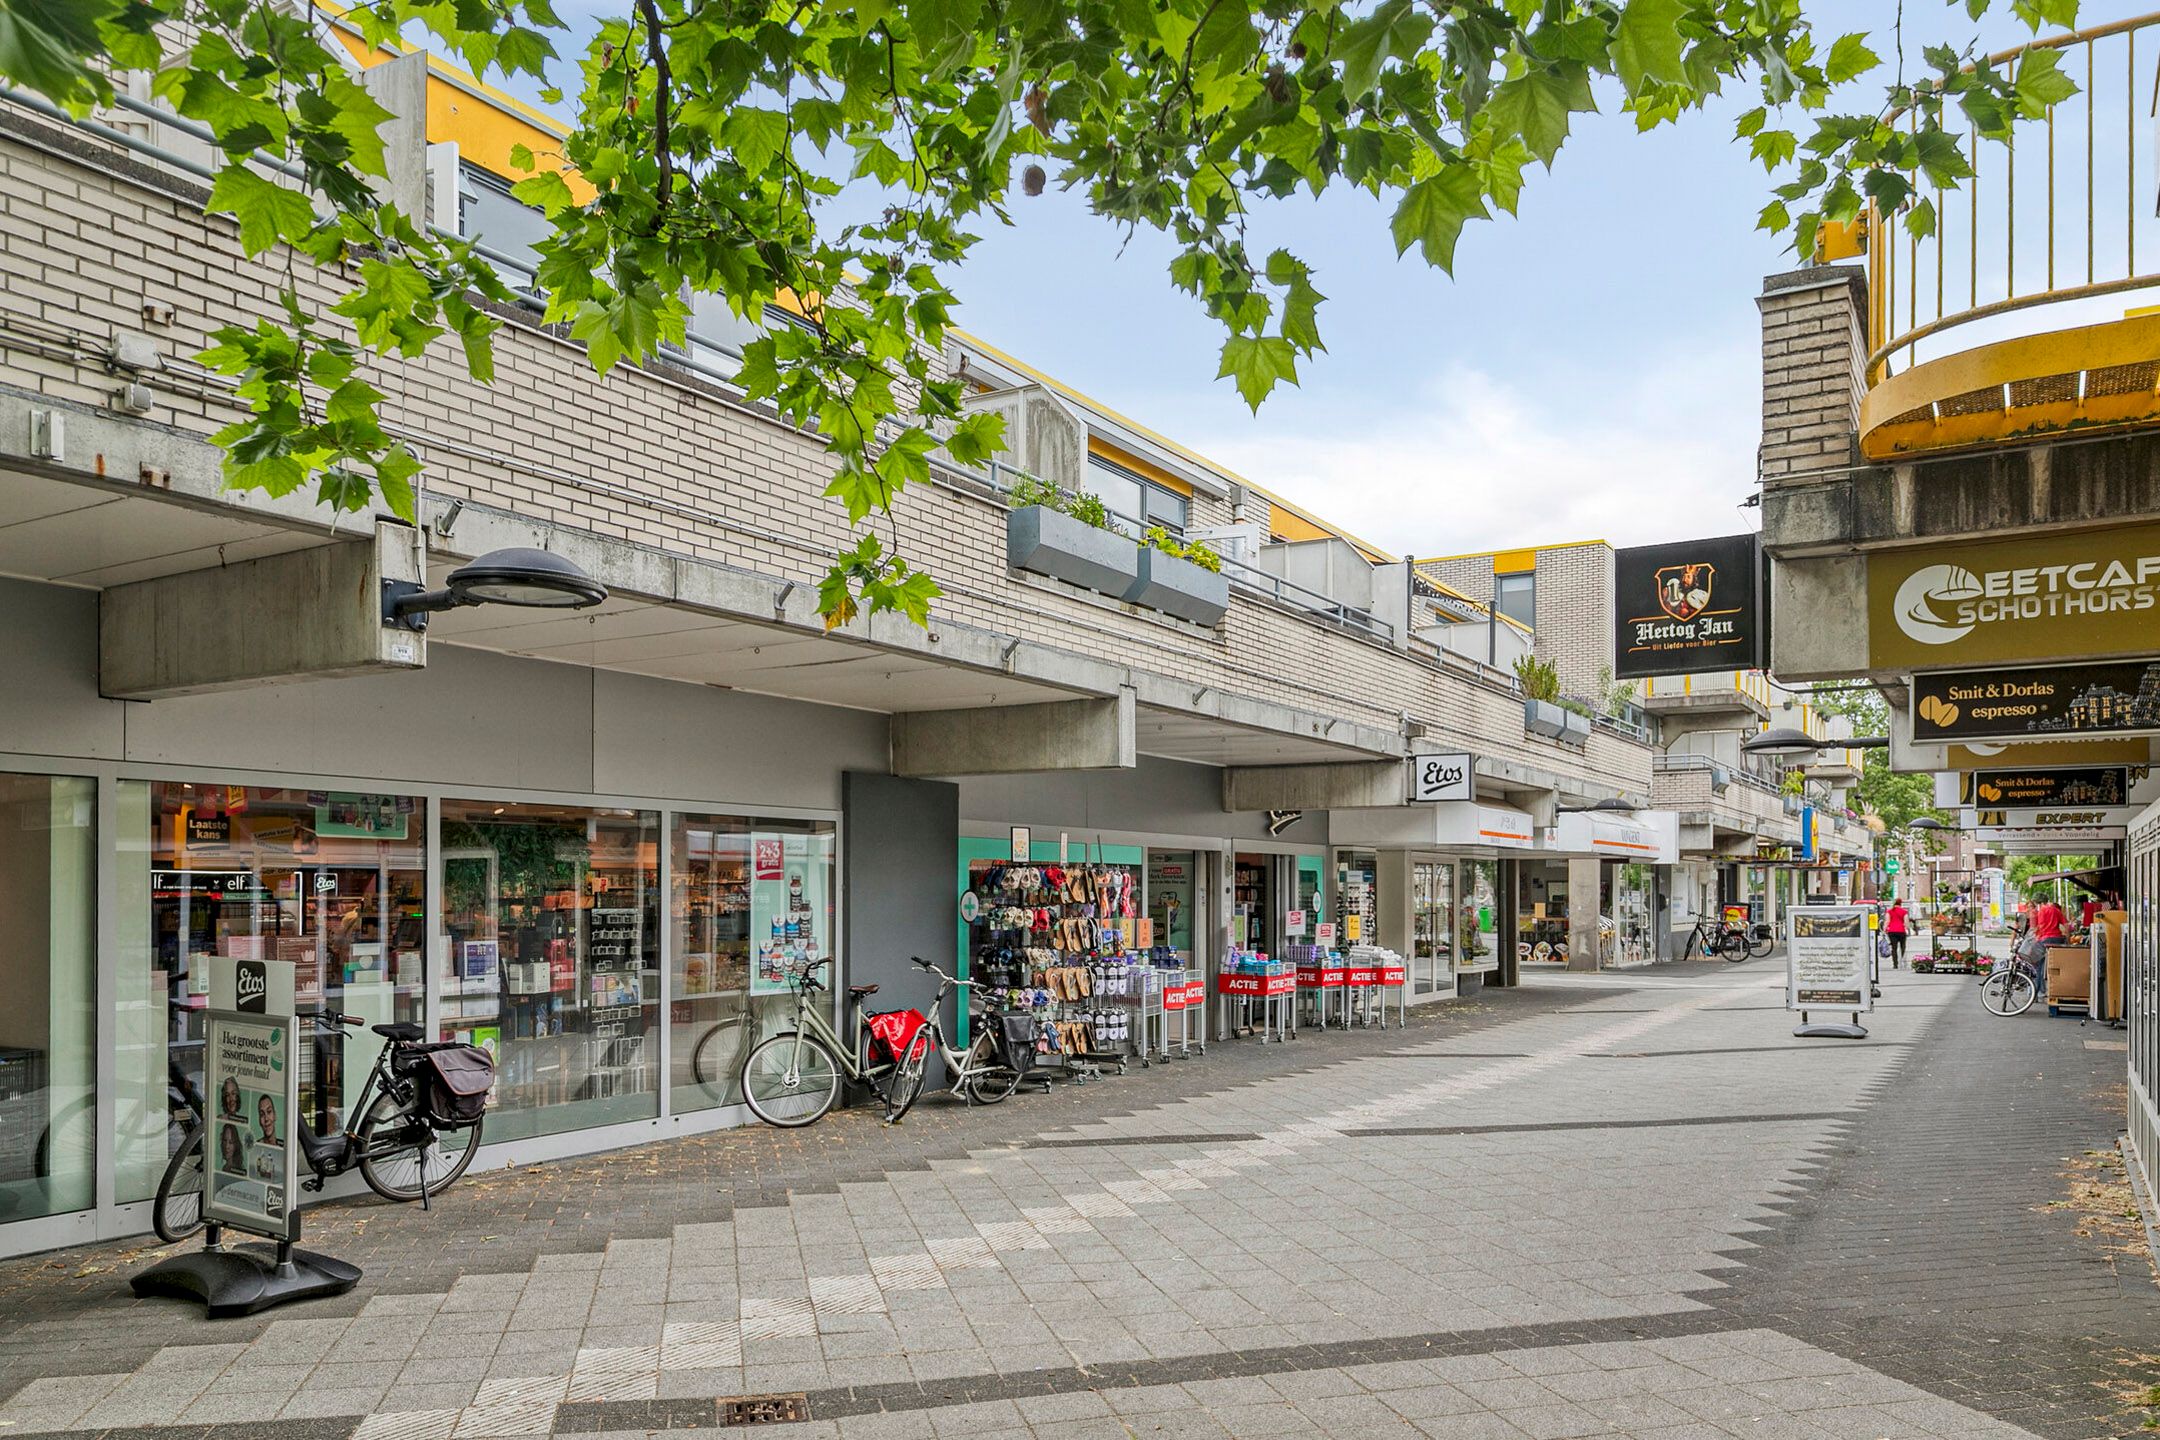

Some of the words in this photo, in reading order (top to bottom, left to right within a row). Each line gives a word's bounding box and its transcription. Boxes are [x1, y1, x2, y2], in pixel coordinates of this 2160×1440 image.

[1957, 585, 2160, 624] SCHOTHORS
[1636, 622, 1696, 645] Hertog
[1698, 617, 1734, 640] Jan
[1663, 641, 1684, 650] Liefde
[1949, 685, 1984, 700] Smit
[1986, 683, 2000, 698] &
[2003, 681, 2054, 698] Dorlas
[1971, 703, 2037, 720] espresso
[1423, 761, 1463, 785] Etos
[1995, 778, 2015, 787] Smit
[2016, 777, 2025, 786] &
[2026, 776, 2055, 786] Dorlas
[2008, 789, 2045, 799] espresso
[189, 819, 228, 830] Laatste
[2036, 812, 2106, 825] EXPERT
[196, 829, 221, 840] kans
[759, 841, 780, 858] 2+3
[761, 858, 779, 868] gratis
[153, 873, 164, 889] lf
[316, 876, 336, 889] Etos
[238, 967, 265, 994] Etos
[1297, 972, 1316, 982] CTIE
[1323, 972, 1344, 983] ACTIE
[1351, 972, 1371, 982] ACTIE
[1384, 971, 1404, 981] ACTIE
[1229, 979, 1259, 990] ACTIE
[1267, 978, 1284, 990] ACTIE
[1166, 992, 1186, 1004] ACTIE
[1185, 986, 1204, 999] ACTIE
[222, 1030, 237, 1046] Het
[236, 1036, 270, 1050] grootste
[222, 1048, 269, 1066] assortiment
[221, 1063, 237, 1074] voor
[267, 1190, 283, 1206] Etos
